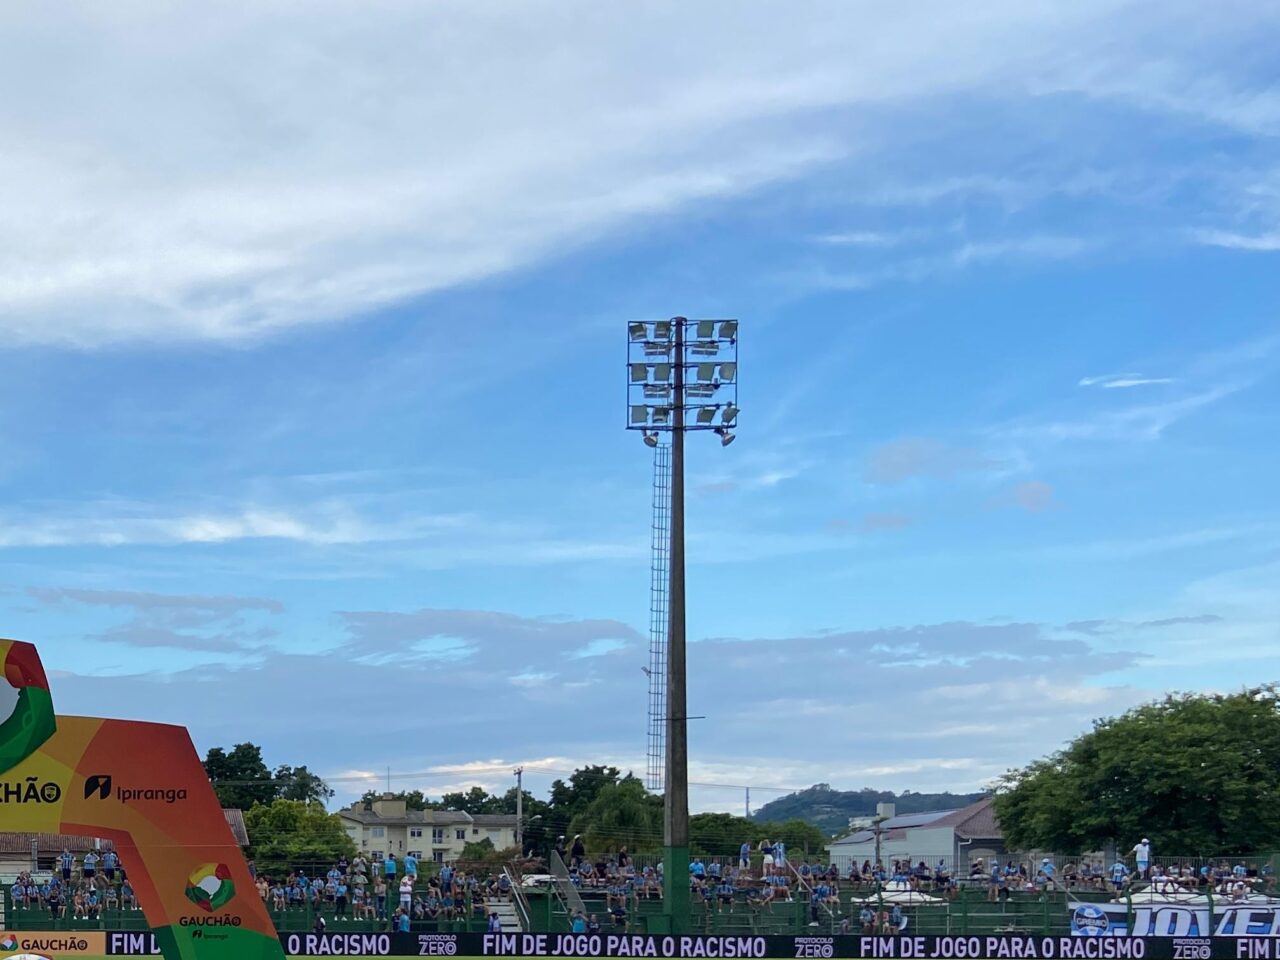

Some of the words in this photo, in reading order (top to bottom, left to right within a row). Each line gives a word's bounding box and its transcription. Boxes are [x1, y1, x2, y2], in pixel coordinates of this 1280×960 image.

[116, 786, 188, 804] Ipiranga
[179, 913, 242, 927] GAUCHÃO
[21, 936, 88, 950] GAUCHÃO
[111, 933, 145, 954] FIM
[288, 934, 300, 955] O
[305, 934, 390, 955] RACISMO
[418, 941, 457, 956] ZERO
[483, 934, 516, 955] FIM
[522, 934, 548, 955] DE
[551, 934, 601, 956] JOGO
[607, 935, 658, 957] PARA
[662, 936, 675, 957] O
[680, 936, 766, 958] RACISMO
[794, 944, 833, 959] ZERO
[860, 937, 894, 958] FIM
[900, 937, 925, 958] DE
[930, 937, 980, 958] JOGO
[986, 937, 1037, 958] PARA
[1042, 937, 1055, 958] O
[1060, 938, 1145, 959] RACISMO
[1236, 938, 1270, 959] FIM
[1172, 945, 1211, 960] ZERO
